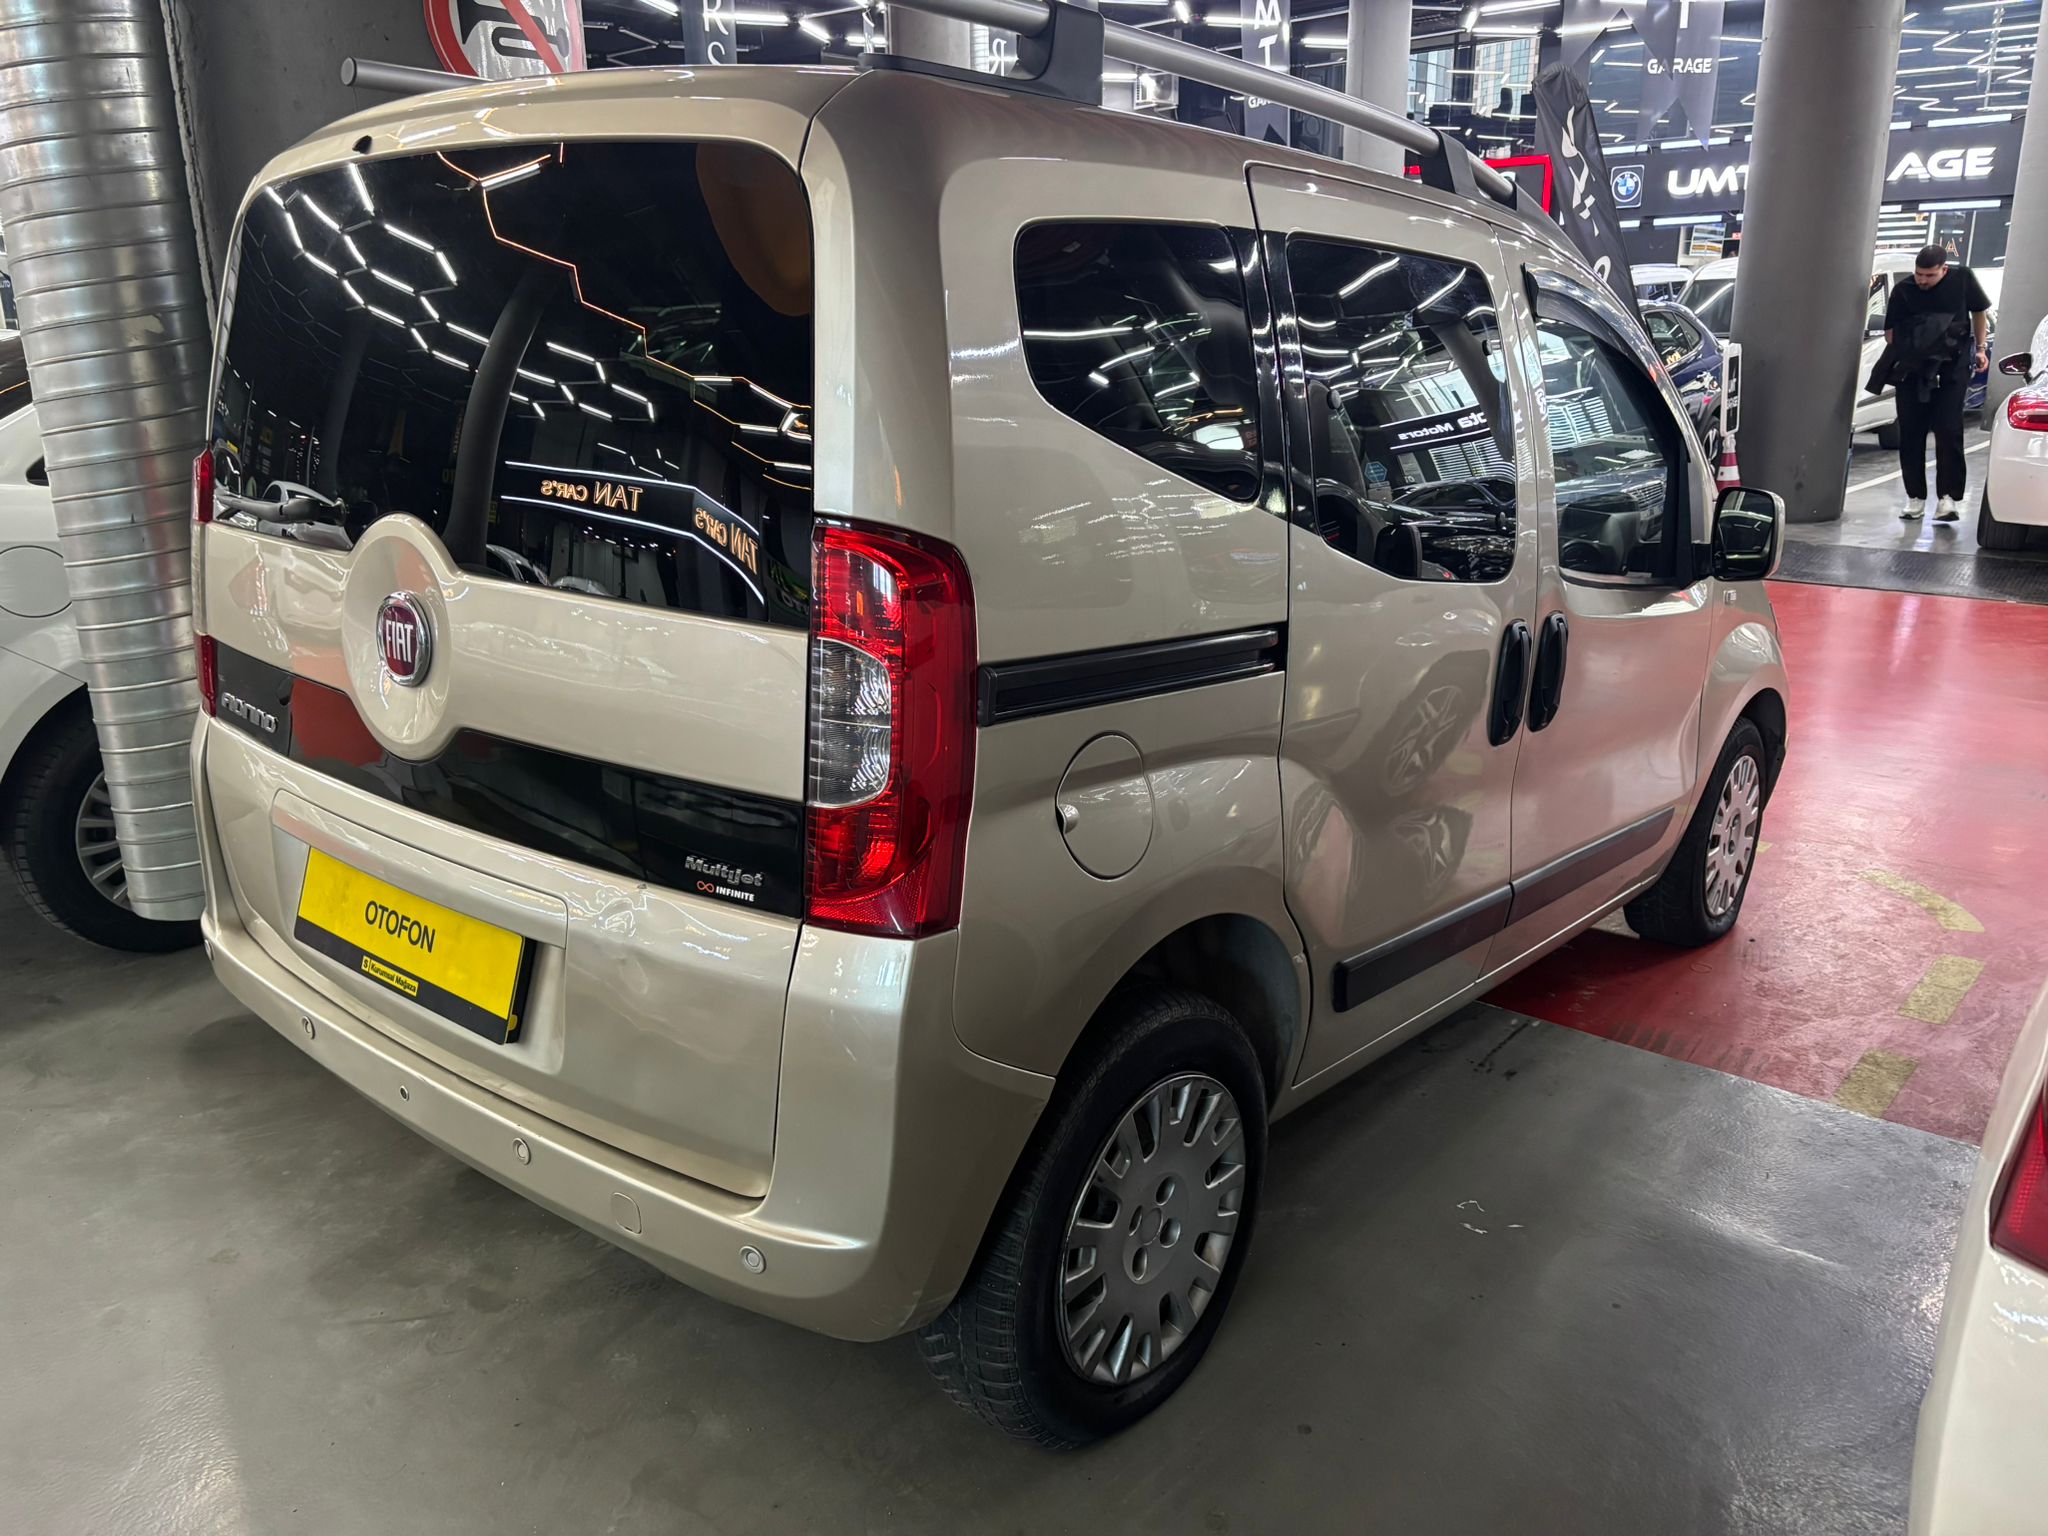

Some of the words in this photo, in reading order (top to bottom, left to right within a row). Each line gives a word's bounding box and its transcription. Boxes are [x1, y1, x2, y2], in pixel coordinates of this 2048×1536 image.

[385, 619, 414, 663] FIAT
[715, 885, 755, 902] INFINITE
[364, 900, 435, 954] OTOFON
